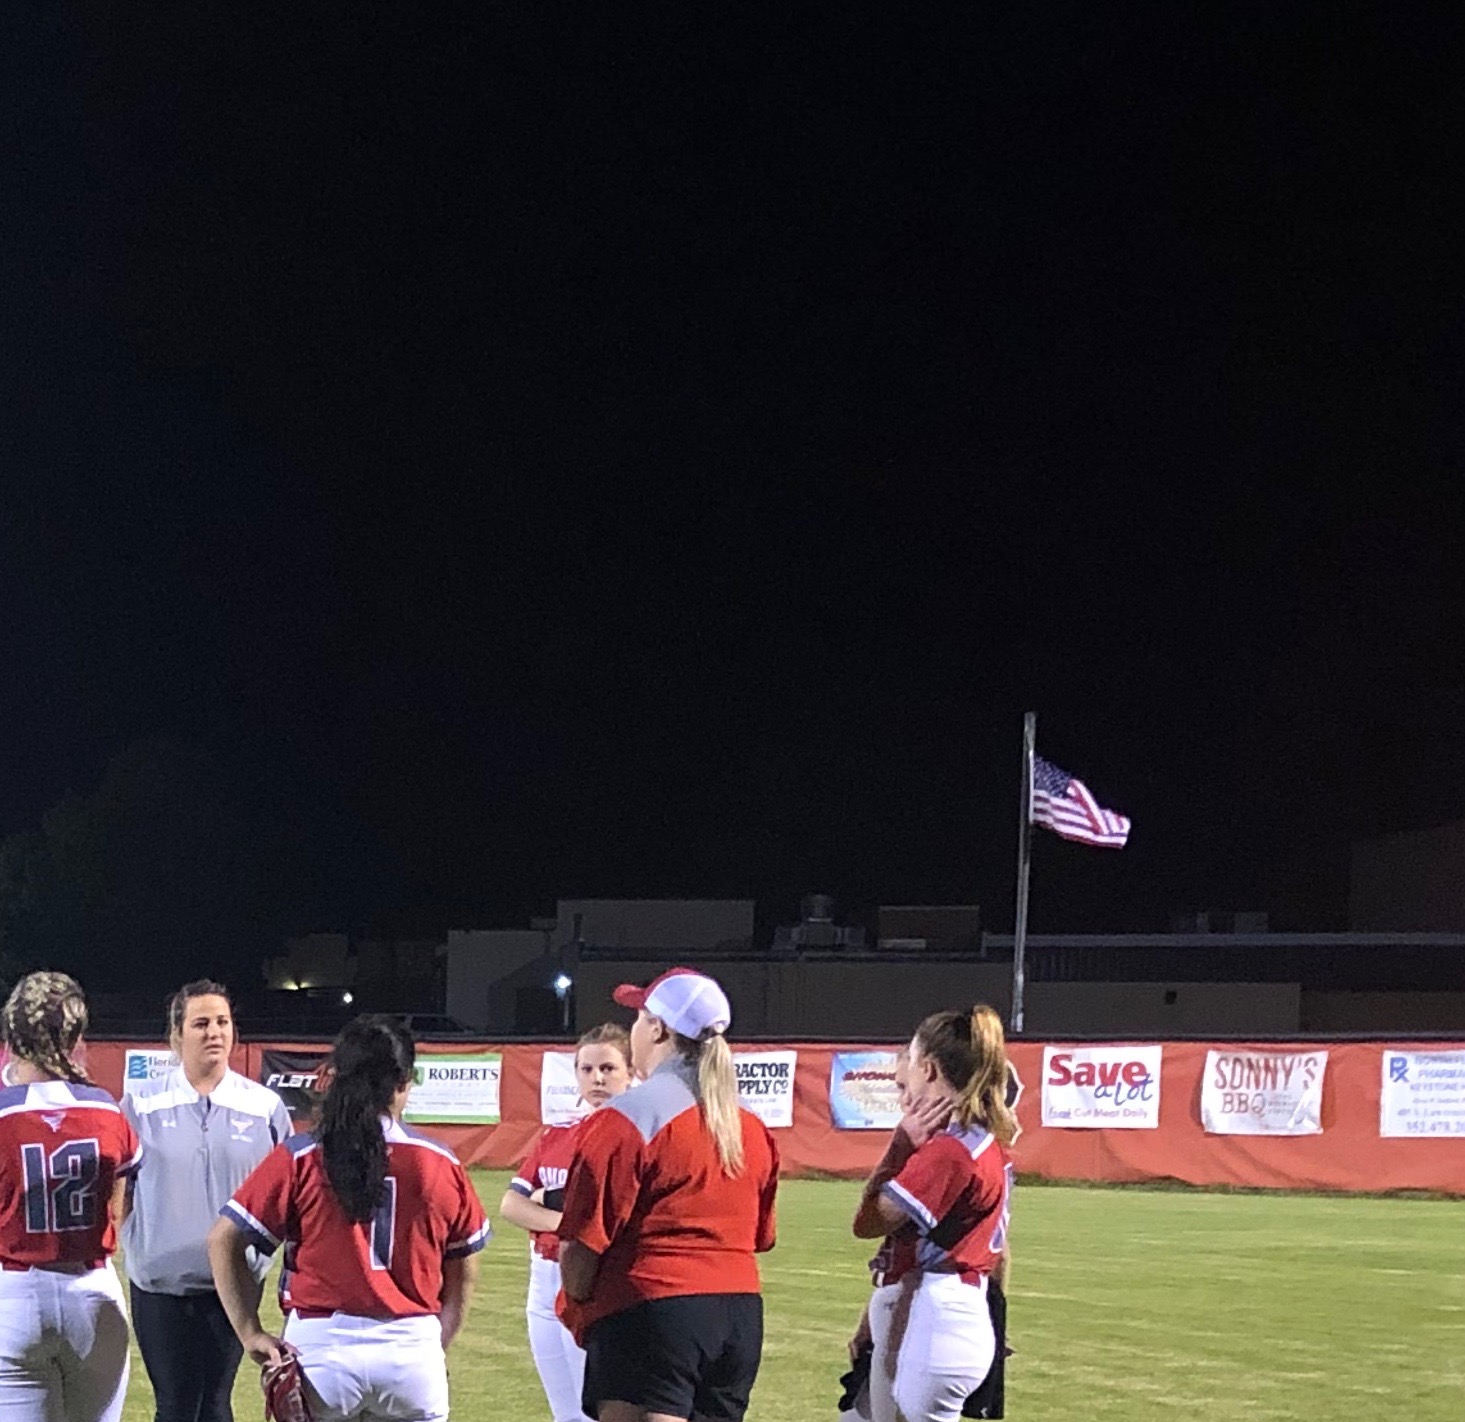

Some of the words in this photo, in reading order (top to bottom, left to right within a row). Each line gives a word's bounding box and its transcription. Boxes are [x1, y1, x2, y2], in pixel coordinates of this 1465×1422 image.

[429, 1068, 499, 1081] ROBERTS
[734, 1063, 789, 1078] RACTOR
[1048, 1054, 1147, 1087] Save
[1214, 1057, 1317, 1090] SONNY'S
[738, 1080, 772, 1095] PPLY
[1220, 1093, 1266, 1118] BBQ
[21, 1138, 100, 1233] 12
